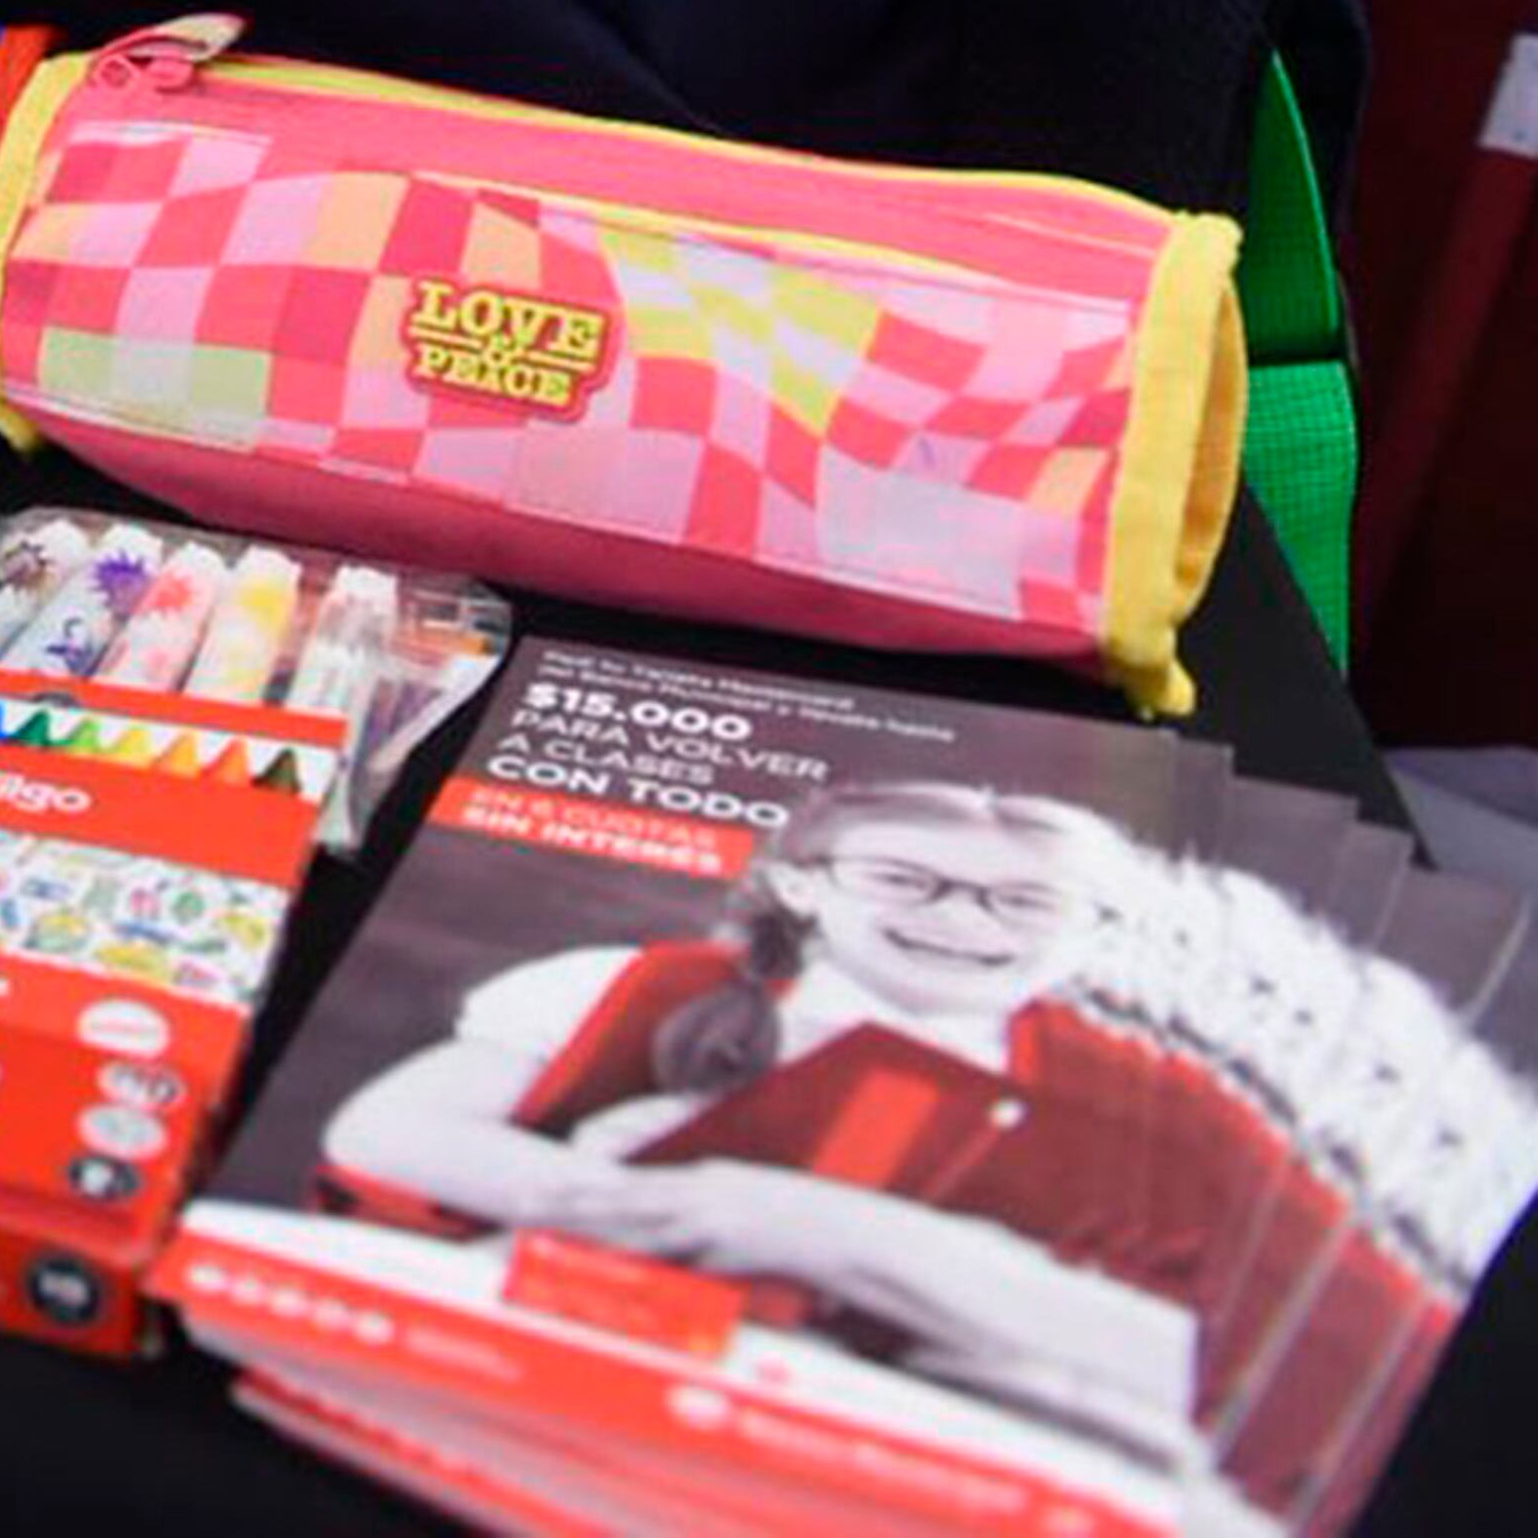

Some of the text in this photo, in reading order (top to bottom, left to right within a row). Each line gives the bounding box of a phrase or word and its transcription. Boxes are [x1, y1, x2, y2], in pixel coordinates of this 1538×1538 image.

[410, 278, 607, 359] LOVE
[412, 344, 573, 406] PEACE
[525, 680, 752, 742] $15.000
[498, 732, 716, 787] A CLASES
[512, 707, 829, 782] PARA VOLVER
[463, 807, 529, 835] SIN
[470, 784, 522, 808] EN
[561, 802, 718, 849] CUOTAS
[487, 754, 789, 828] CON TODO
